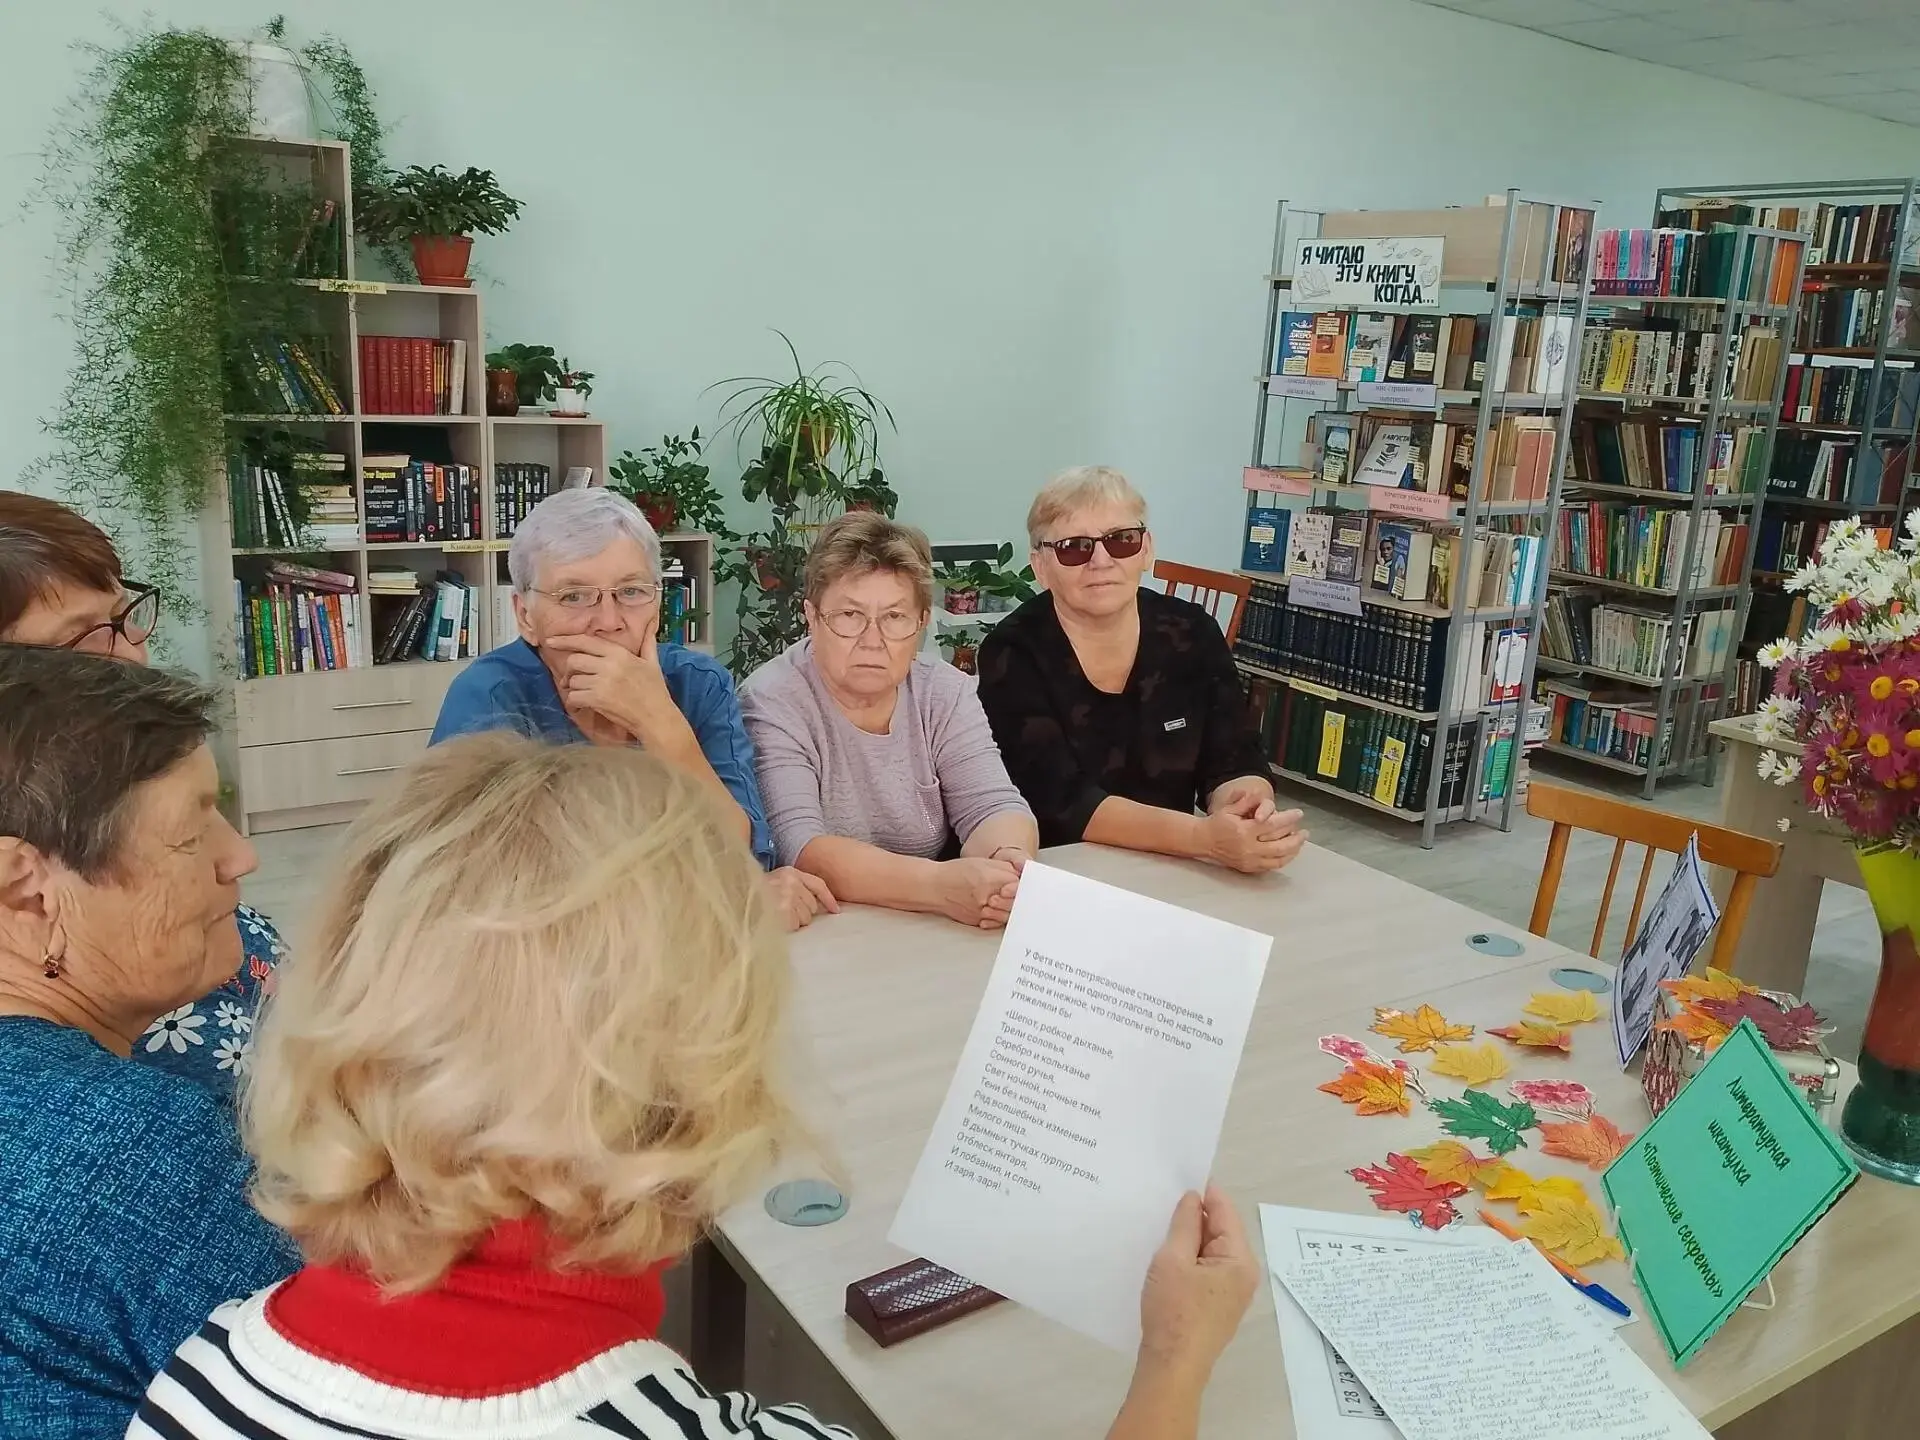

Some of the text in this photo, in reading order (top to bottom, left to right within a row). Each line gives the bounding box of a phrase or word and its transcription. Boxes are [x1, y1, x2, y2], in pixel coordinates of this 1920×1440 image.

[1301, 245, 1364, 265] Я ЧИТАЮ
[1335, 264, 1418, 285] ЭТУ КНИГУ,
[1374, 284, 1434, 305] КОГДА...
[1054, 961, 1073, 973] есть
[1074, 968, 1136, 996] потрясающее
[1010, 990, 1057, 1014] утяжеляли
[1020, 963, 1056, 983] котором
[1057, 976, 1073, 988] нет
[1074, 982, 1085, 992] ни
[1086, 988, 1117, 1005] одного
[1175, 1022, 1223, 1046] настолько
[1001, 1021, 1026, 1040] Трели
[1046, 988, 1052, 996] и
[1090, 1004, 1105, 1016] что
[1106, 1011, 1143, 1031] глаголы
[1144, 1026, 1160, 1038] его
[1160, 1031, 1191, 1050] только
[1039, 1024, 1072, 1041] робкое
[995, 1036, 1032, 1056] Серебро
[990, 1048, 1026, 1071] Сонного
[981, 1076, 1000, 1092] Тени
[1002, 1086, 1017, 1099] без
[985, 1063, 1005, 1078] Свет
[1042, 1087, 1078, 1107] ночные
[968, 1103, 1002, 1125] Милого
[974, 1090, 990, 1105] Ряд
[991, 1099, 1044, 1127] волшебных
[1726, 1075, 1791, 1171] Литературная
[956, 1131, 995, 1155] Отблеск
[962, 1117, 970, 1127] В
[968, 1123, 1008, 1144] дымных
[1009, 1138, 1040, 1160] тучках
[1039, 1152, 1073, 1174] пурпур
[1707, 1119, 1752, 1187] шкатулка
[944, 1159, 954, 1169] И
[951, 1145, 959, 1155] И
[1003, 1170, 1011, 1179] и
[1644, 1142, 1726, 1298] «Поэтические секреты»
[1339, 1371, 1356, 1384] 73
[1343, 1390, 1361, 1404] 28
